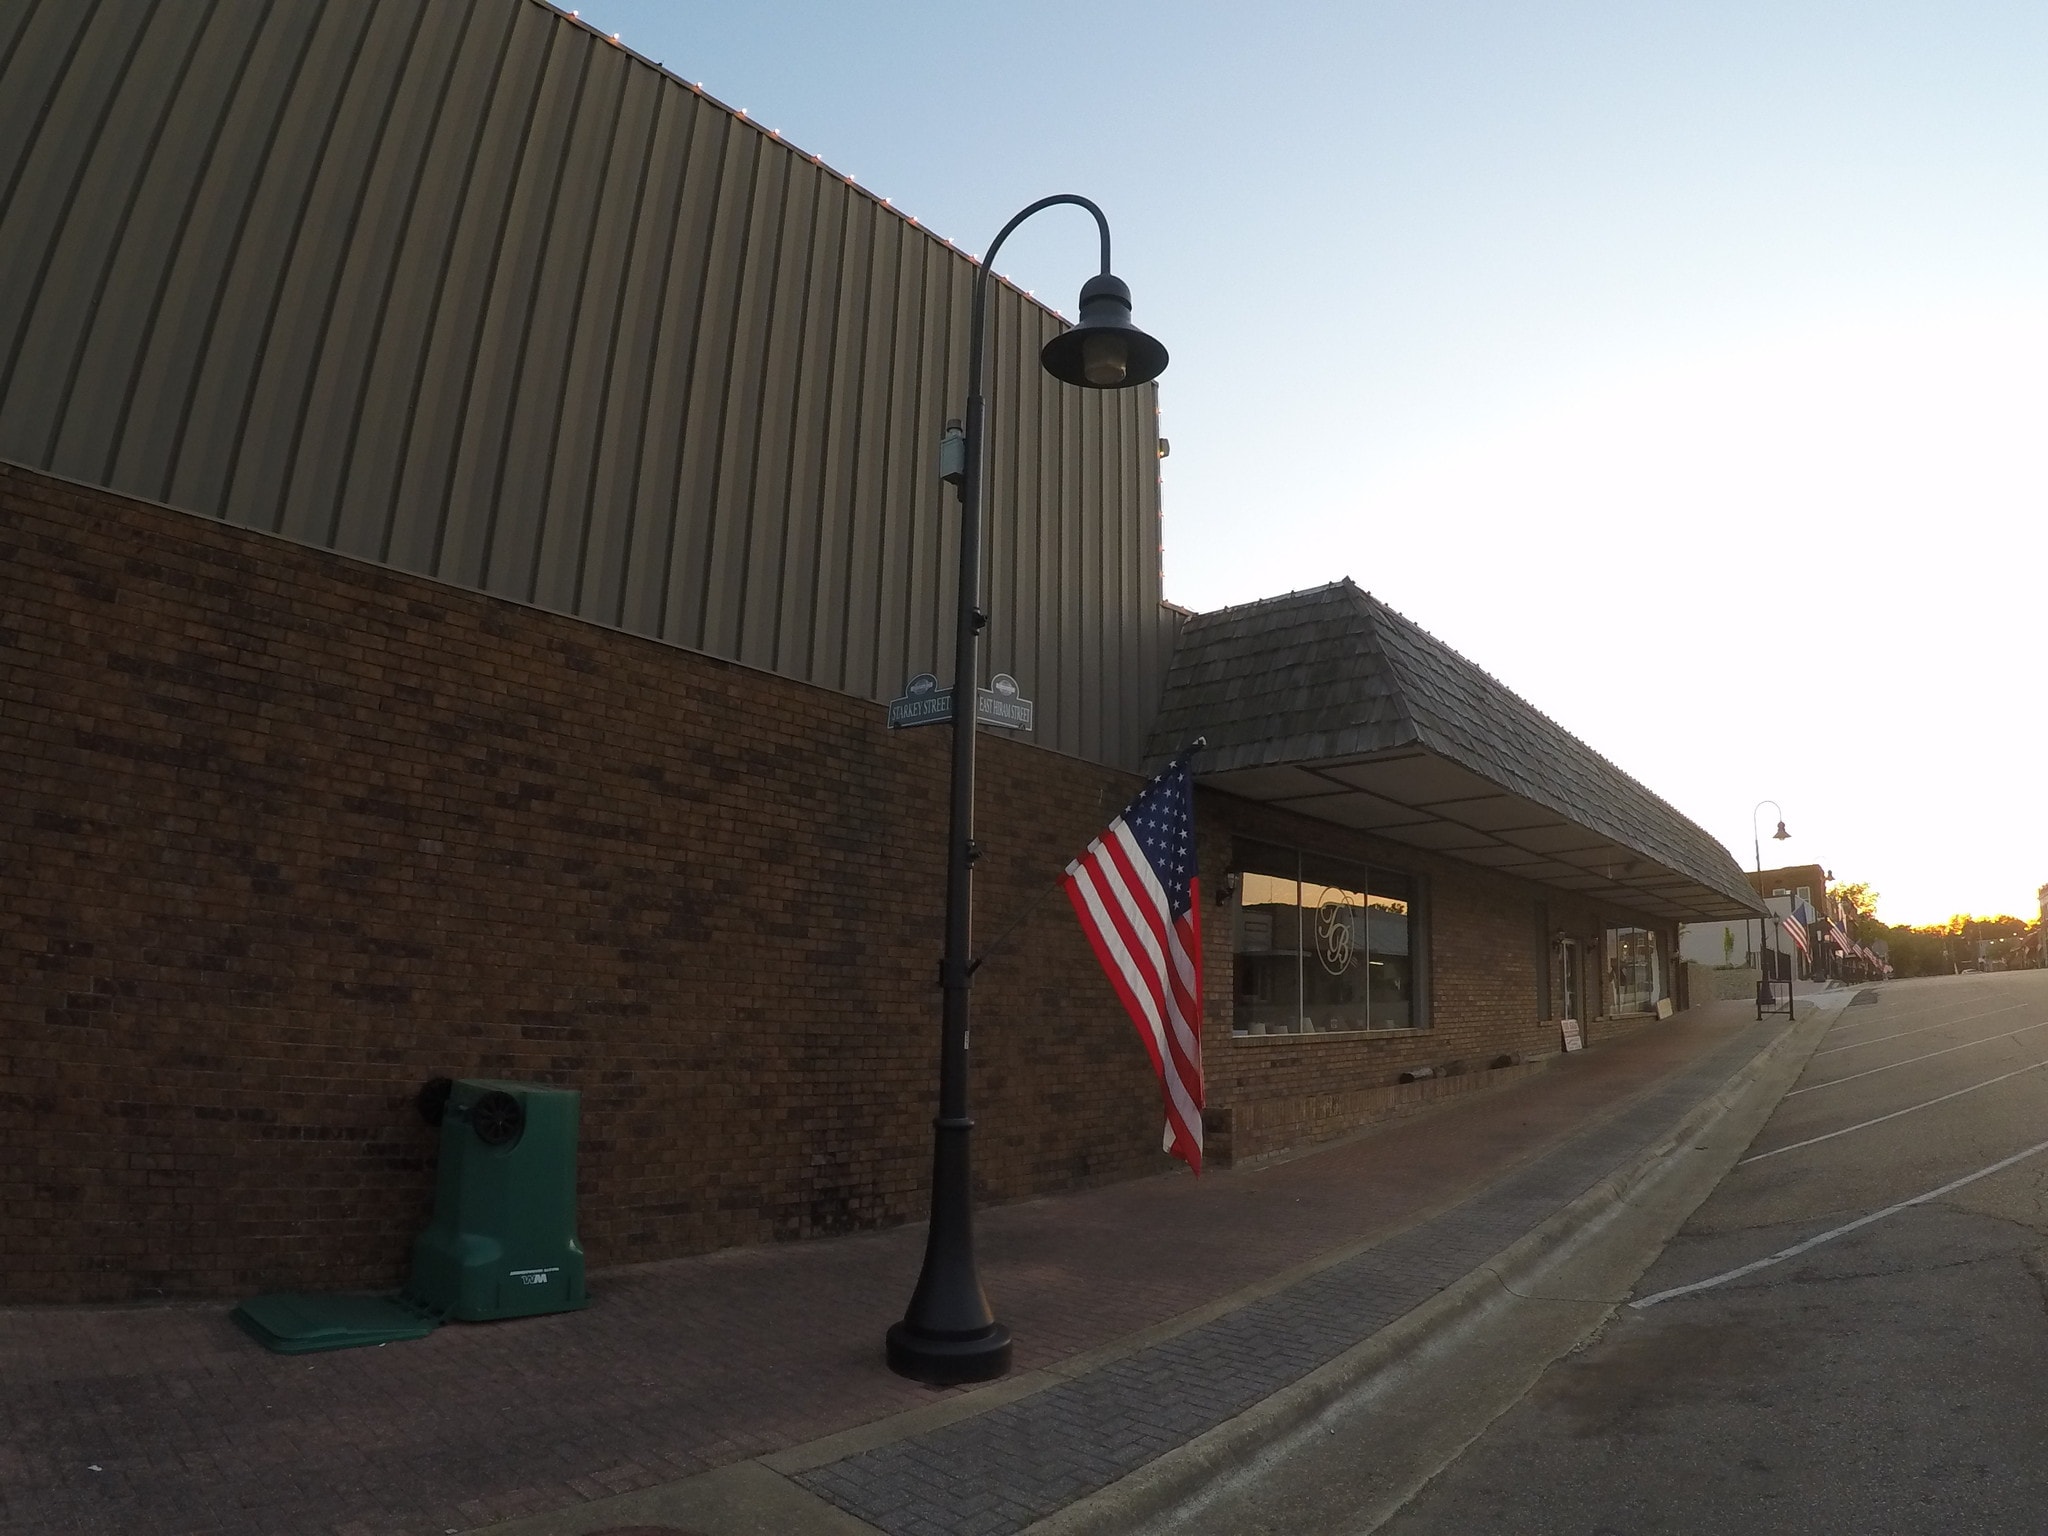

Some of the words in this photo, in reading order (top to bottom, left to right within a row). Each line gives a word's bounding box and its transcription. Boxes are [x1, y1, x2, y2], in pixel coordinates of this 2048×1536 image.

[891, 701, 922, 721] STARKEY
[923, 695, 951, 715] STREET
[979, 696, 993, 714] EAST
[1011, 705, 1030, 722] STREET
